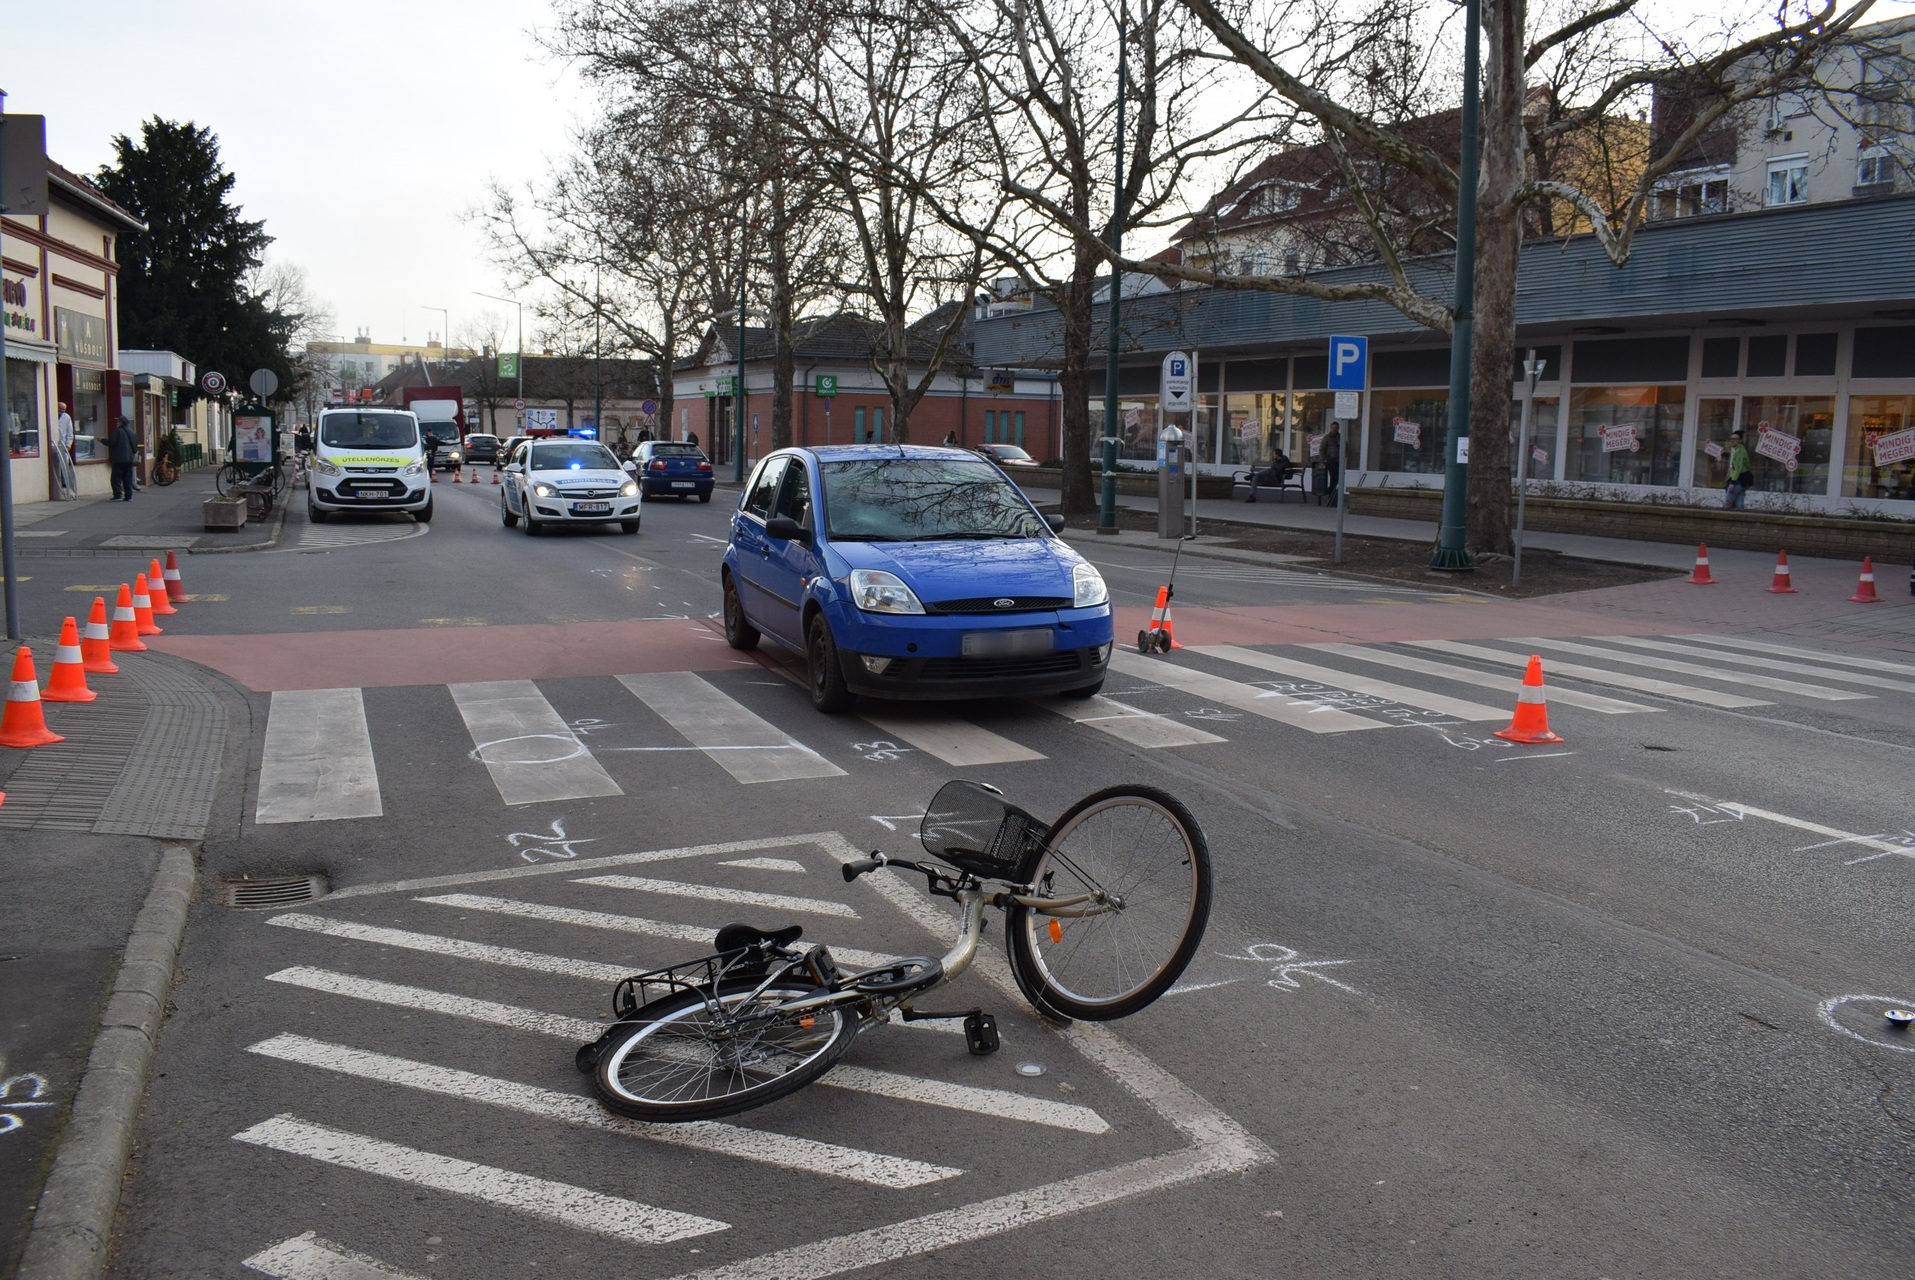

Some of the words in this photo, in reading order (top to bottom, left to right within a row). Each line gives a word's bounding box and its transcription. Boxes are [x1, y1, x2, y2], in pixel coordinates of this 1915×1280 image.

[86, 321, 92, 338] A
[75, 340, 103, 357] HÚSBOLT
[1336, 343, 1360, 376] P
[1174, 362, 1182, 375] P
[1605, 428, 1630, 439] MINDIG
[1764, 433, 1794, 451] MINDIG
[1877, 435, 1911, 451] MINDIG
[342, 455, 400, 463] ÚTELLENŐRZÉS
[578, 503, 608, 511] MFR-817
